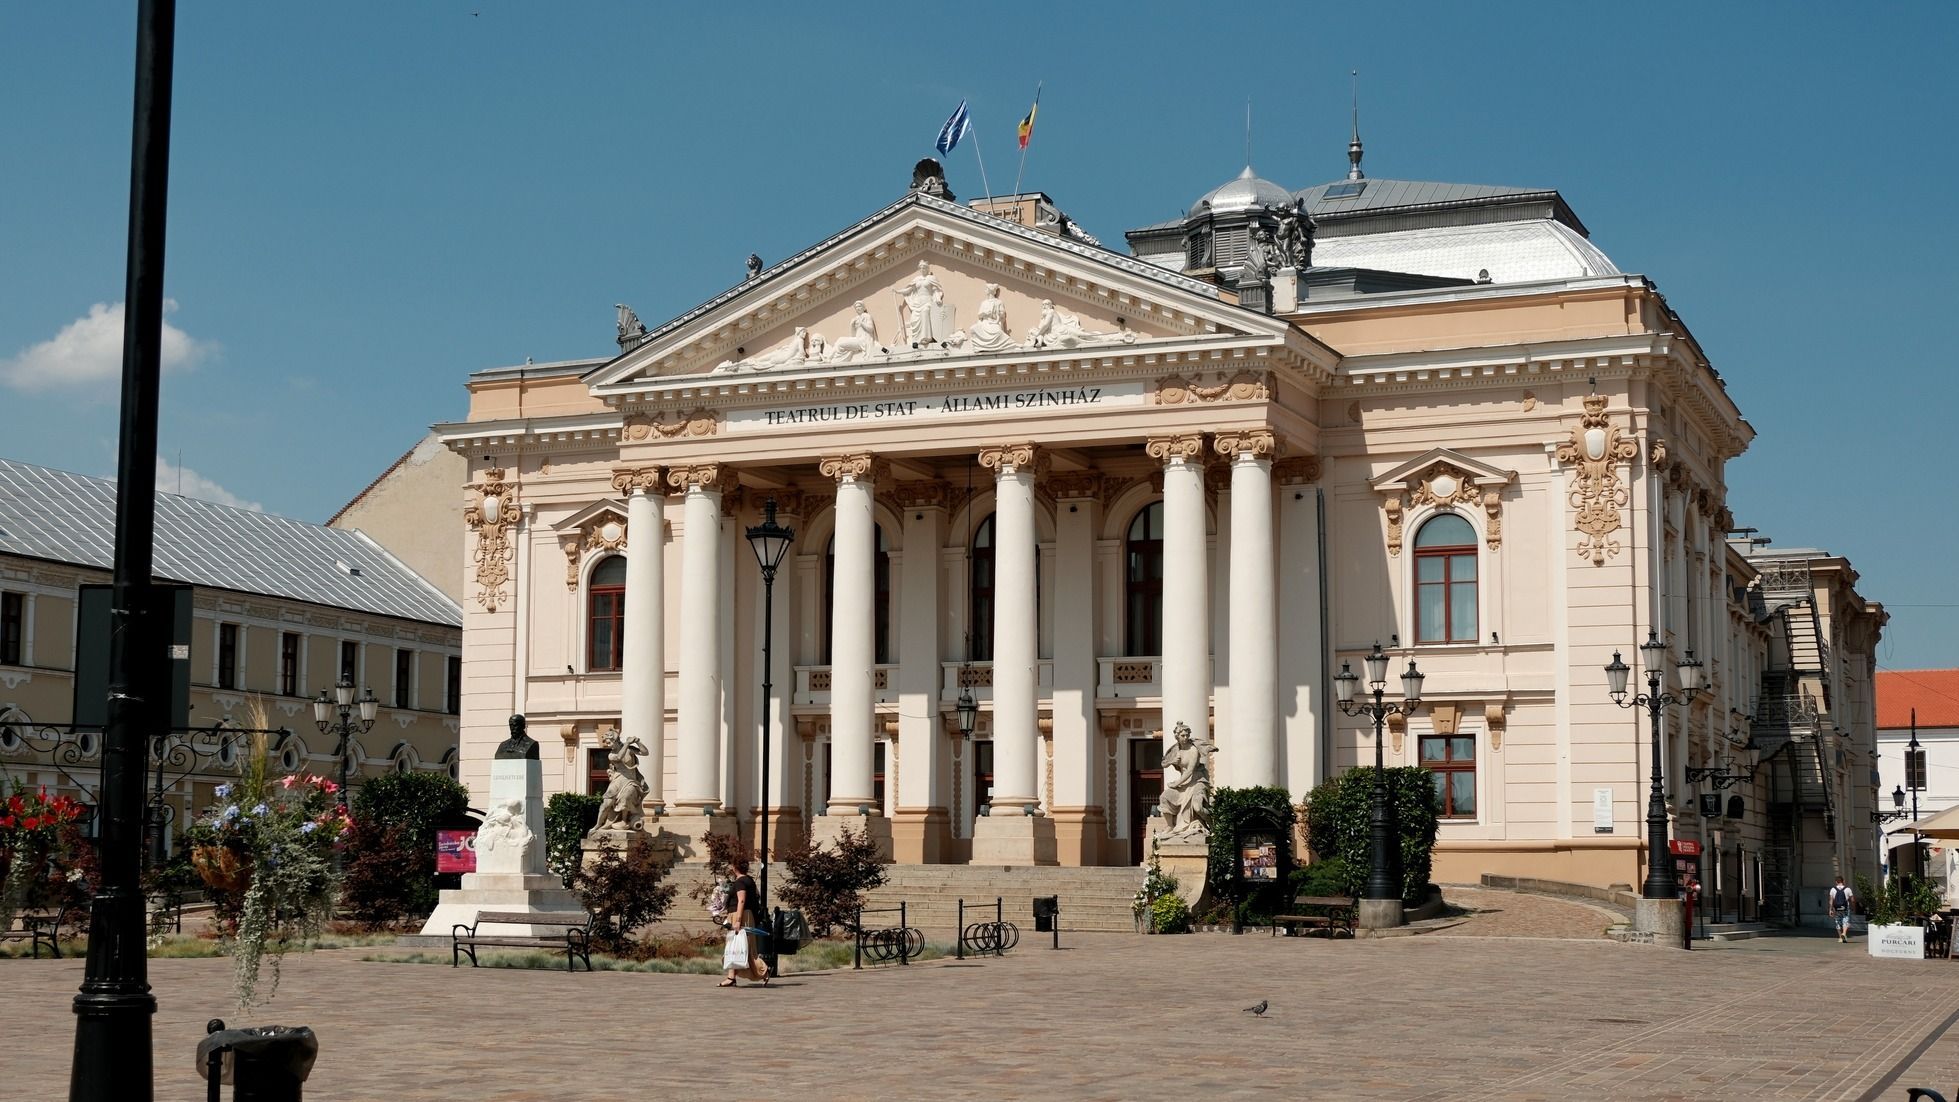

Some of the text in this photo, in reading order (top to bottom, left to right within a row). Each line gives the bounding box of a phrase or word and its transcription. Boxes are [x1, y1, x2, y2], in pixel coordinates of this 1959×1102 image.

[765, 386, 1101, 425] TEATRUL DE STAT ÁLLAMI SZÍNHÁZ
